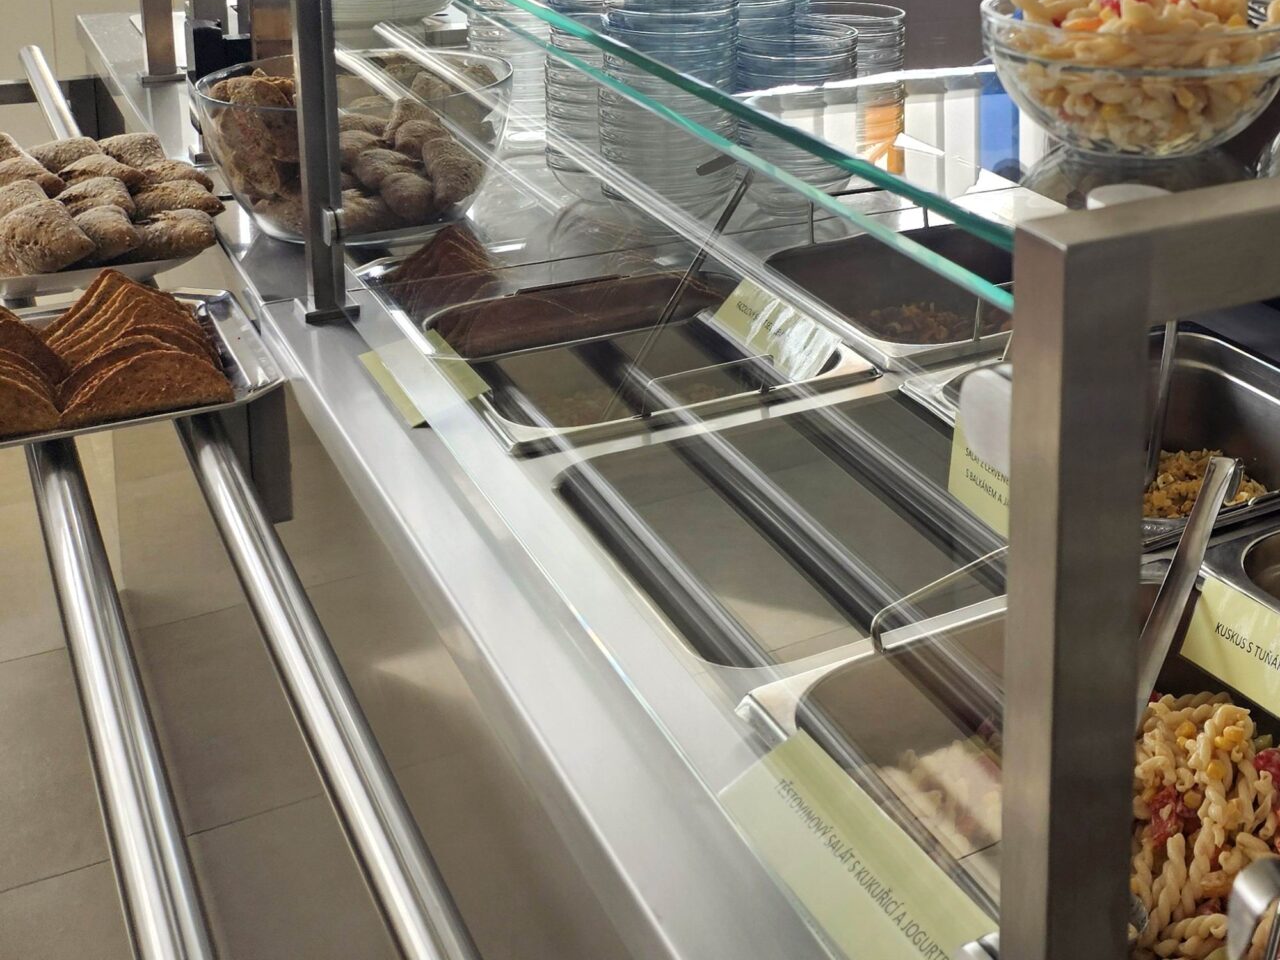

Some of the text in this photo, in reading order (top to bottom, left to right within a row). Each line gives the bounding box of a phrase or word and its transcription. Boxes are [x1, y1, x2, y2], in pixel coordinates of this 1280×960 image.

[1214, 621, 1247, 650] KUSKUS
[1246, 641, 1254, 654] S
[774, 778, 833, 842] TĚSTOVINOVÝ
[823, 832, 854, 864] SALÁT
[848, 860, 860, 873] S
[853, 866, 903, 916] KUKUŘICÍ
[892, 911, 907, 926] A
